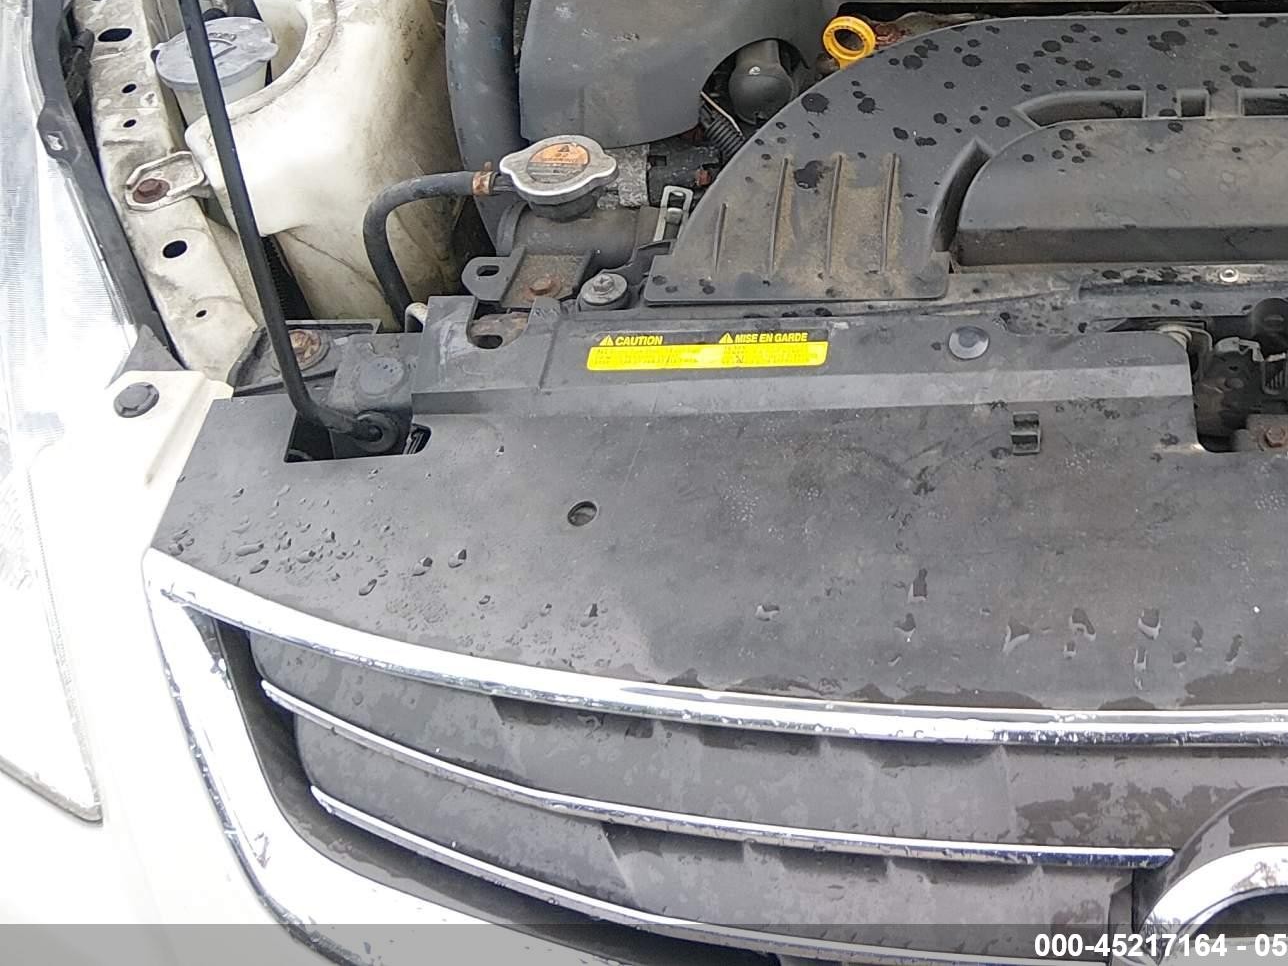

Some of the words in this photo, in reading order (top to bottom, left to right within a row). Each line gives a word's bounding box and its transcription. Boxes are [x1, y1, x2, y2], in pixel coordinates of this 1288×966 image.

[615, 335, 664, 346] CAUTION
[734, 333, 758, 343] MISE
[759, 332, 774, 343] EN
[774, 332, 808, 342] GARDE
